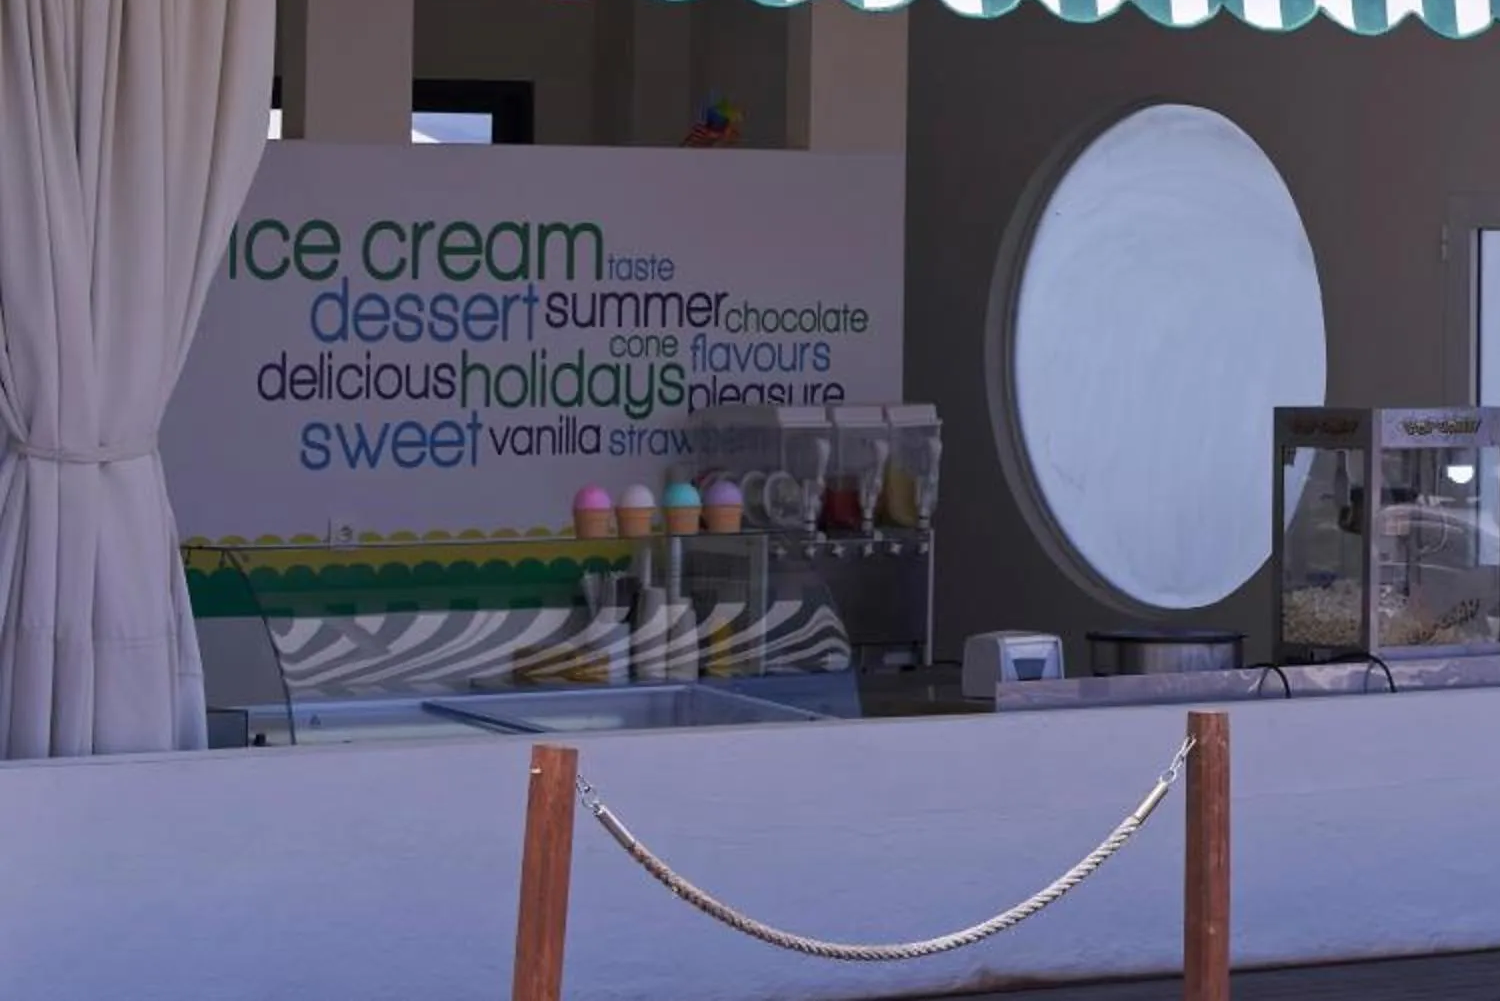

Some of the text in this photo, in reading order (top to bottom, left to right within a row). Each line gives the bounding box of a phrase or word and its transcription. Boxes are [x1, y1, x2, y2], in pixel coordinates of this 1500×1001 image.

[228, 218, 675, 281] ice cream taste
[310, 276, 869, 342] dessert summer chocolate
[257, 348, 845, 419] delicious holidays pleasure
[609, 333, 831, 373] cone flavours
[300, 410, 483, 470] sweet
[487, 415, 602, 456] vanilla
